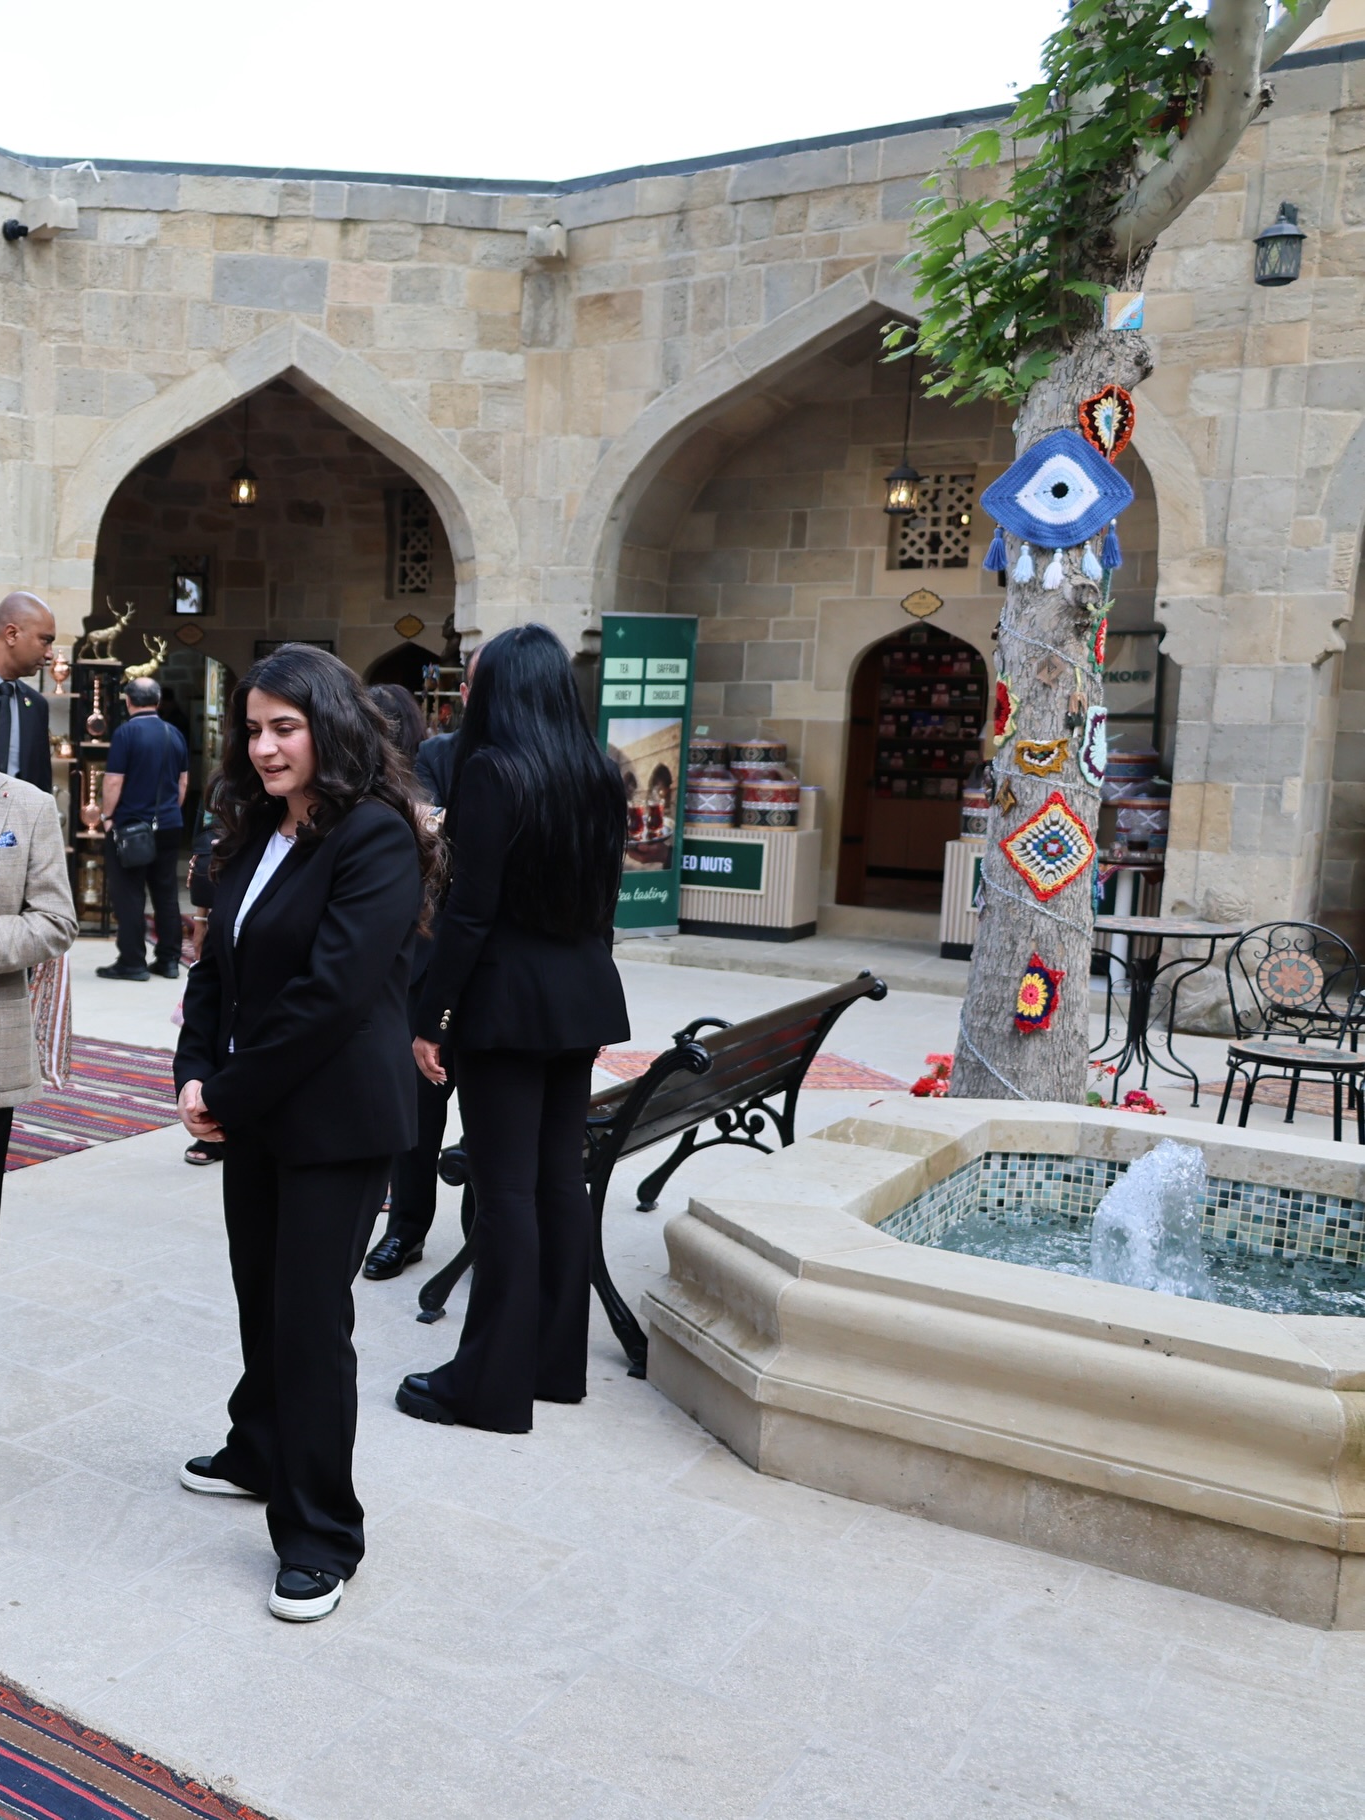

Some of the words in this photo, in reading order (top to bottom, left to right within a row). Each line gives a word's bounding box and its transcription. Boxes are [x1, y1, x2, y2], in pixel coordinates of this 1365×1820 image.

[619, 663, 629, 674] TEA
[656, 663, 680, 674] SAFFRON
[615, 689, 632, 700] HONEY
[652, 690, 680, 700] CHOCOLATE
[681, 854, 698, 870] ED
[700, 855, 733, 873] NUTS
[633, 886, 669, 904] tasting
